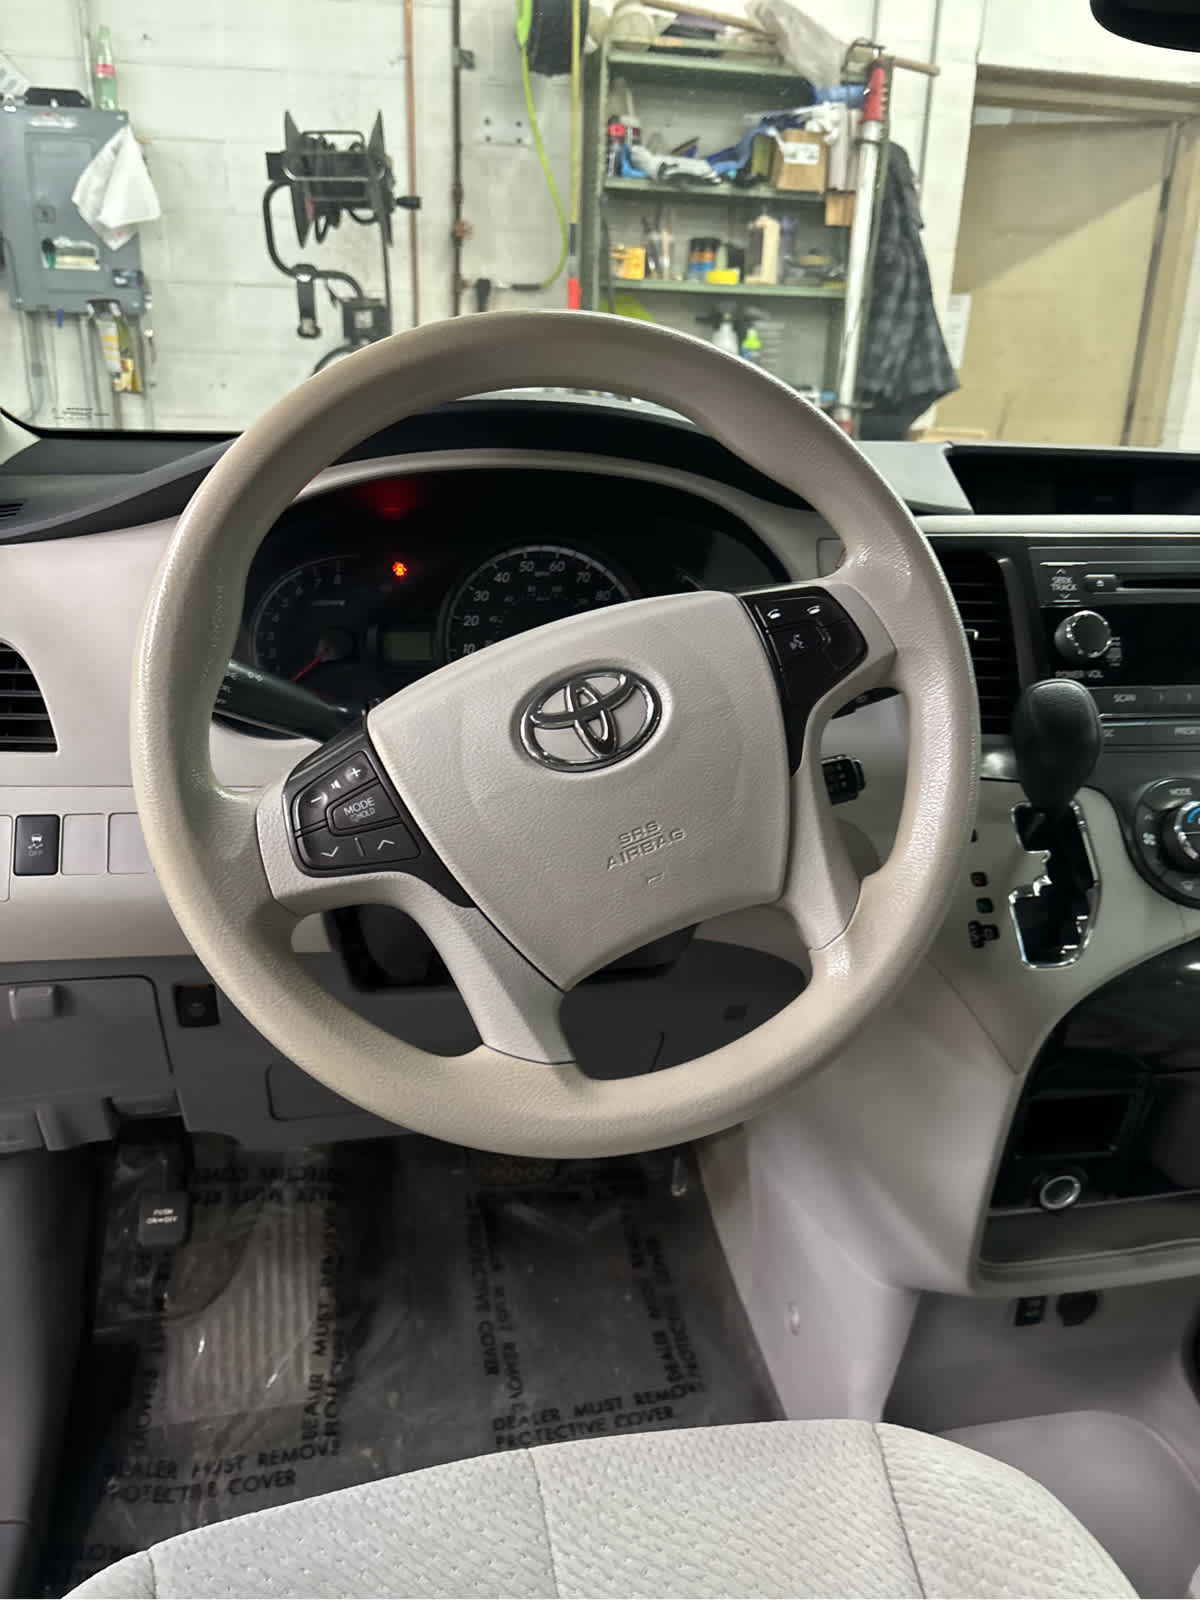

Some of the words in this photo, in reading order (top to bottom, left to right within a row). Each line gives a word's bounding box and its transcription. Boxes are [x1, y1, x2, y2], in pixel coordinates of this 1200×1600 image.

[520, 560, 536, 572] 50
[549, 560, 566, 572] 60
[493, 572, 511, 583] 40
[576, 571, 592, 583] 70
[473, 589, 490, 602] 30
[463, 615, 480, 627] 20
[343, 796, 376, 816] MODE
[618, 820, 662, 846] SRS
[607, 828, 687, 871] AIRBAG
[573, 1396, 624, 1417] MUST
[496, 1416, 607, 1449] PROTECTIVE
[614, 1405, 674, 1429] COVER
[228, 1469, 297, 1496] COVER
